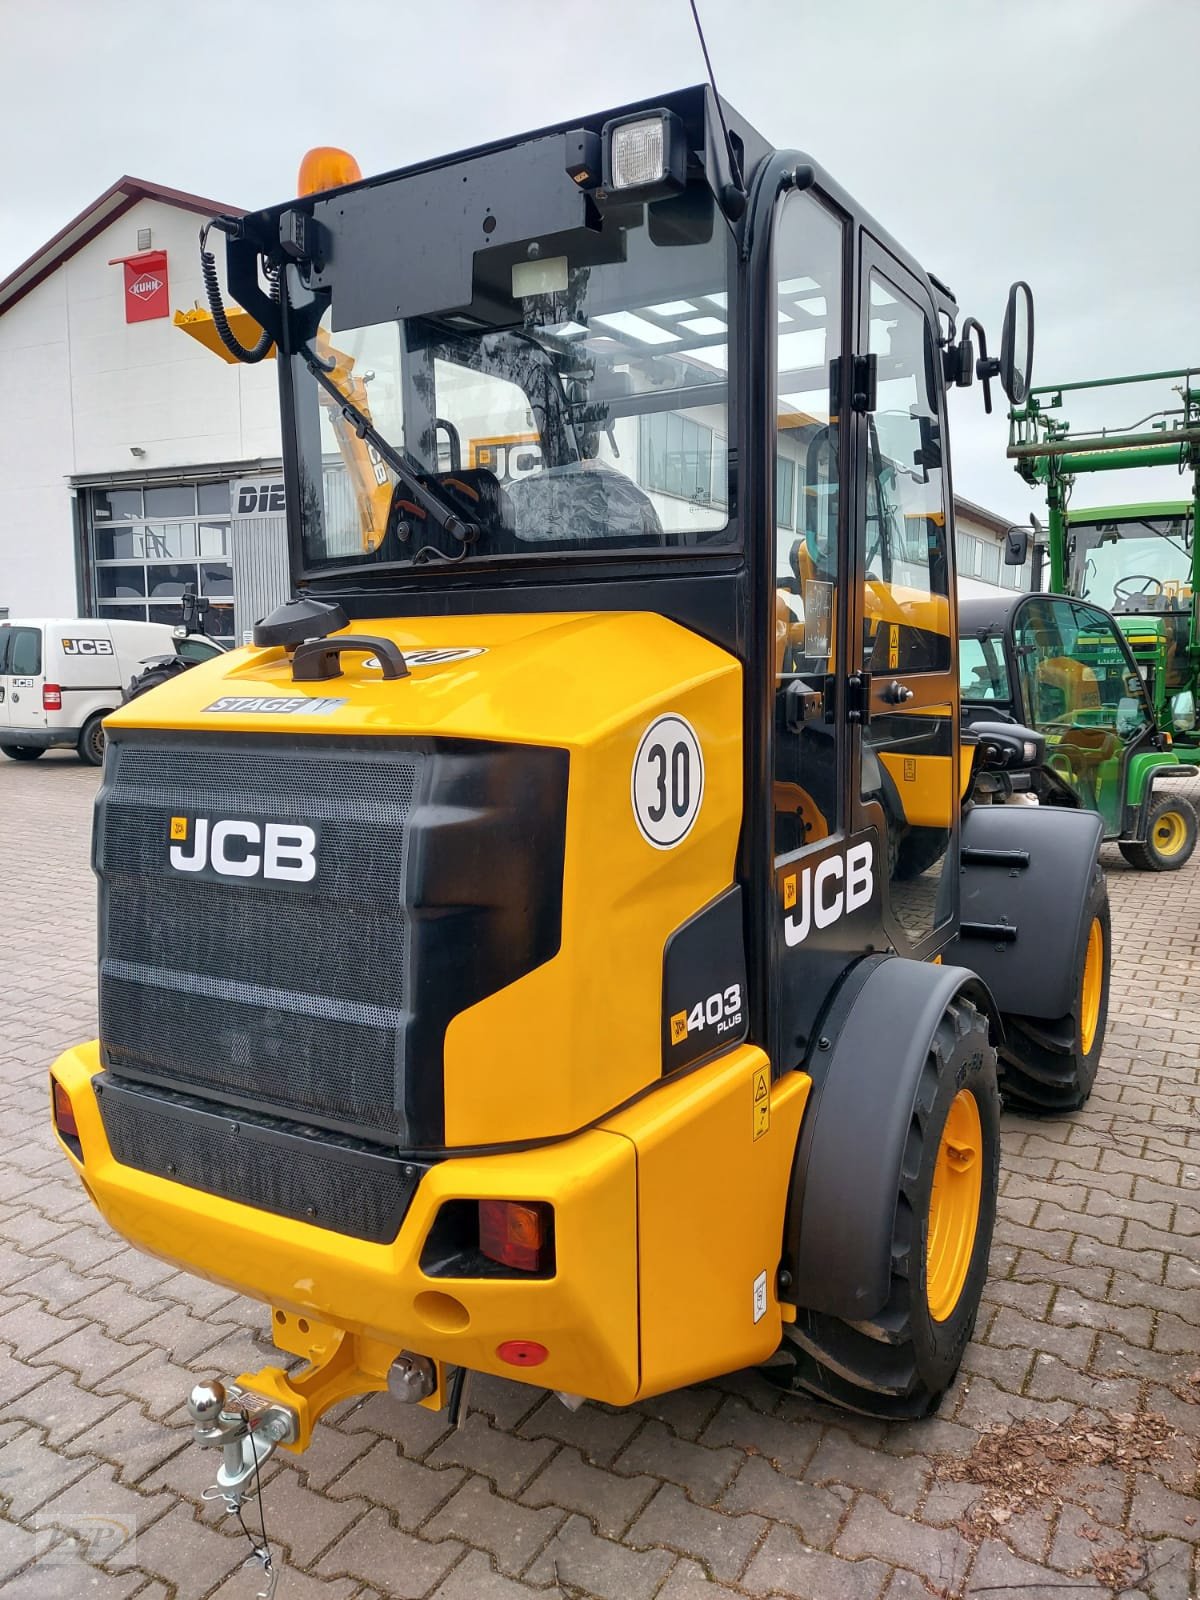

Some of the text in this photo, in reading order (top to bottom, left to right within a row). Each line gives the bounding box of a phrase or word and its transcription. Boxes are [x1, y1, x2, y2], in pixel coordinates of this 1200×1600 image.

[133, 281, 158, 294] KUHN
[64, 640, 112, 654] JCB
[206, 698, 304, 712] STAGE
[647, 741, 690, 822] 30
[169, 818, 316, 882] JCB
[784, 841, 873, 947] JCB
[687, 985, 741, 1032] 403
[716, 1013, 742, 1035] PLUS
